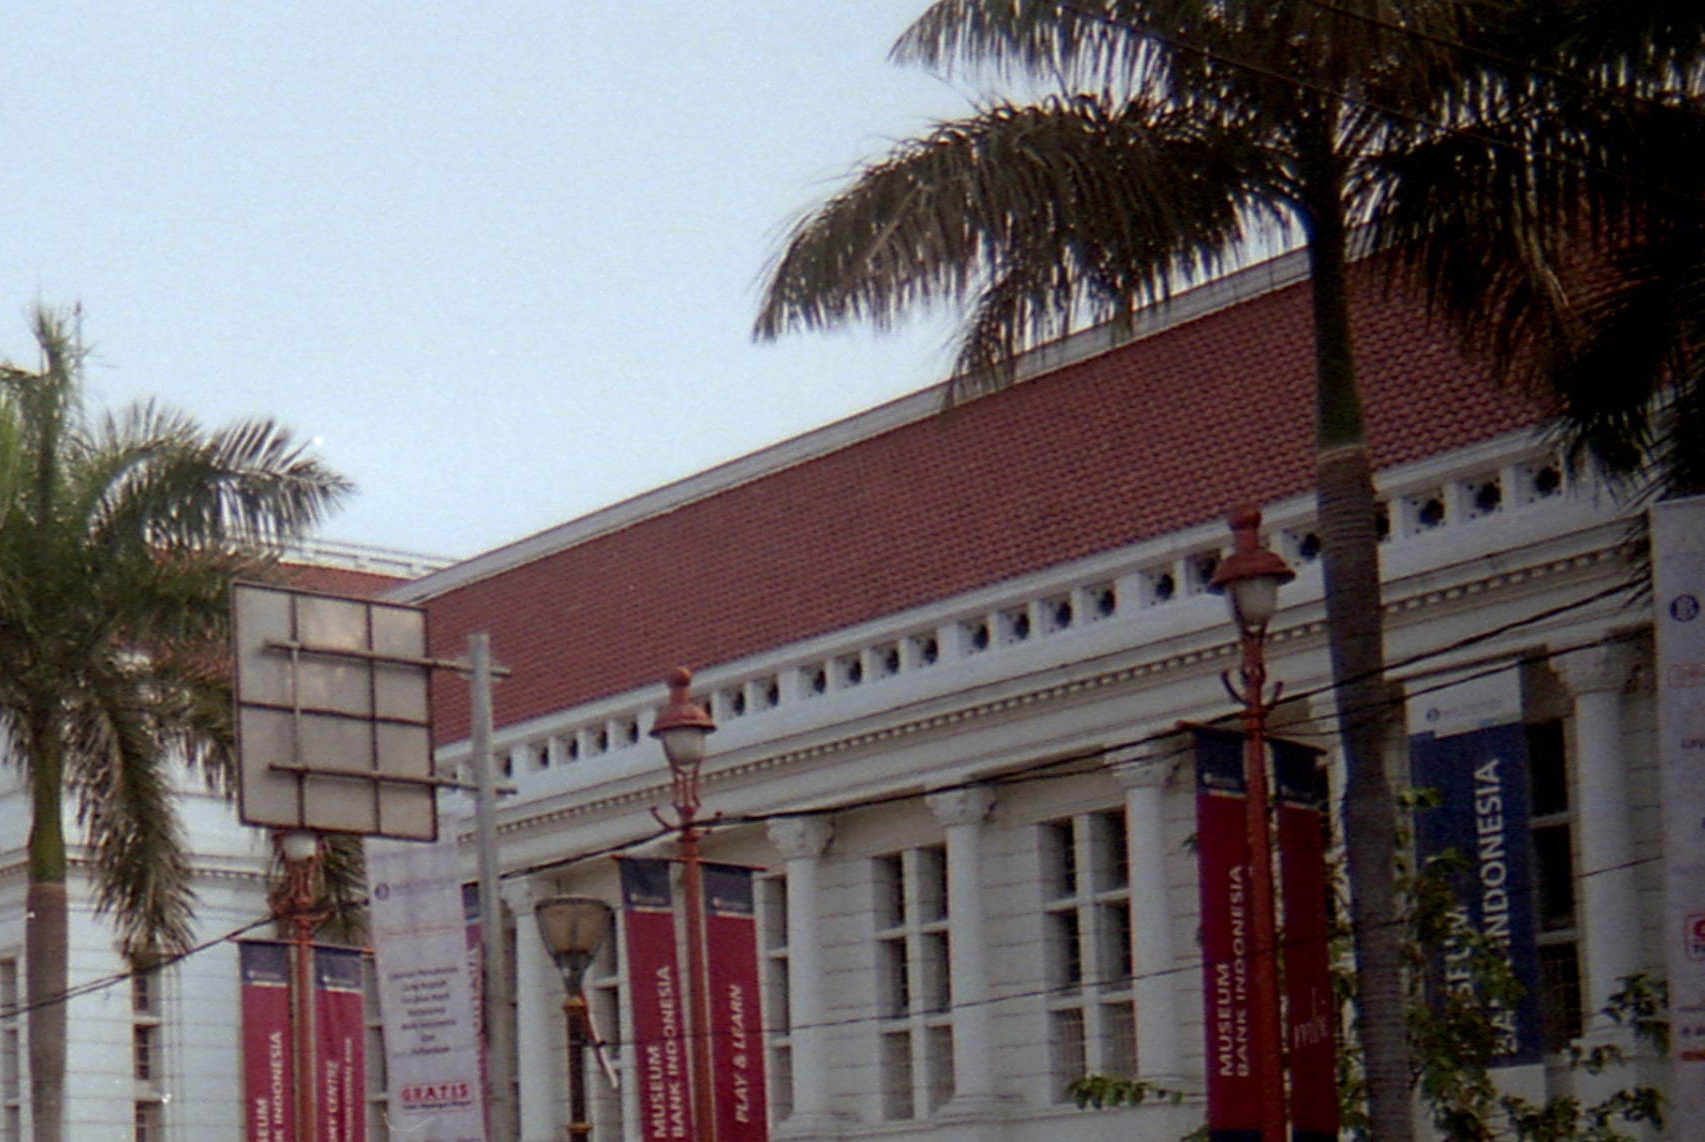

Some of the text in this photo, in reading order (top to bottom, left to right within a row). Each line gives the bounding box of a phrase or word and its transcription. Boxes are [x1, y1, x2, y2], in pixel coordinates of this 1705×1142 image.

[1473, 758, 1511, 947] INDONESIA
[1216, 963, 1234, 1077] MUSEUM
[1229, 865, 1250, 1077] BANK INDONESIA
[269, 1031, 284, 1125] INDONESIA
[401, 1083, 469, 1103] GRATIS
[647, 1045, 667, 1138] MUSEUM
[656, 965, 685, 1138] BANK INDONESIA
[730, 984, 750, 1124] PLAY & LEARN
